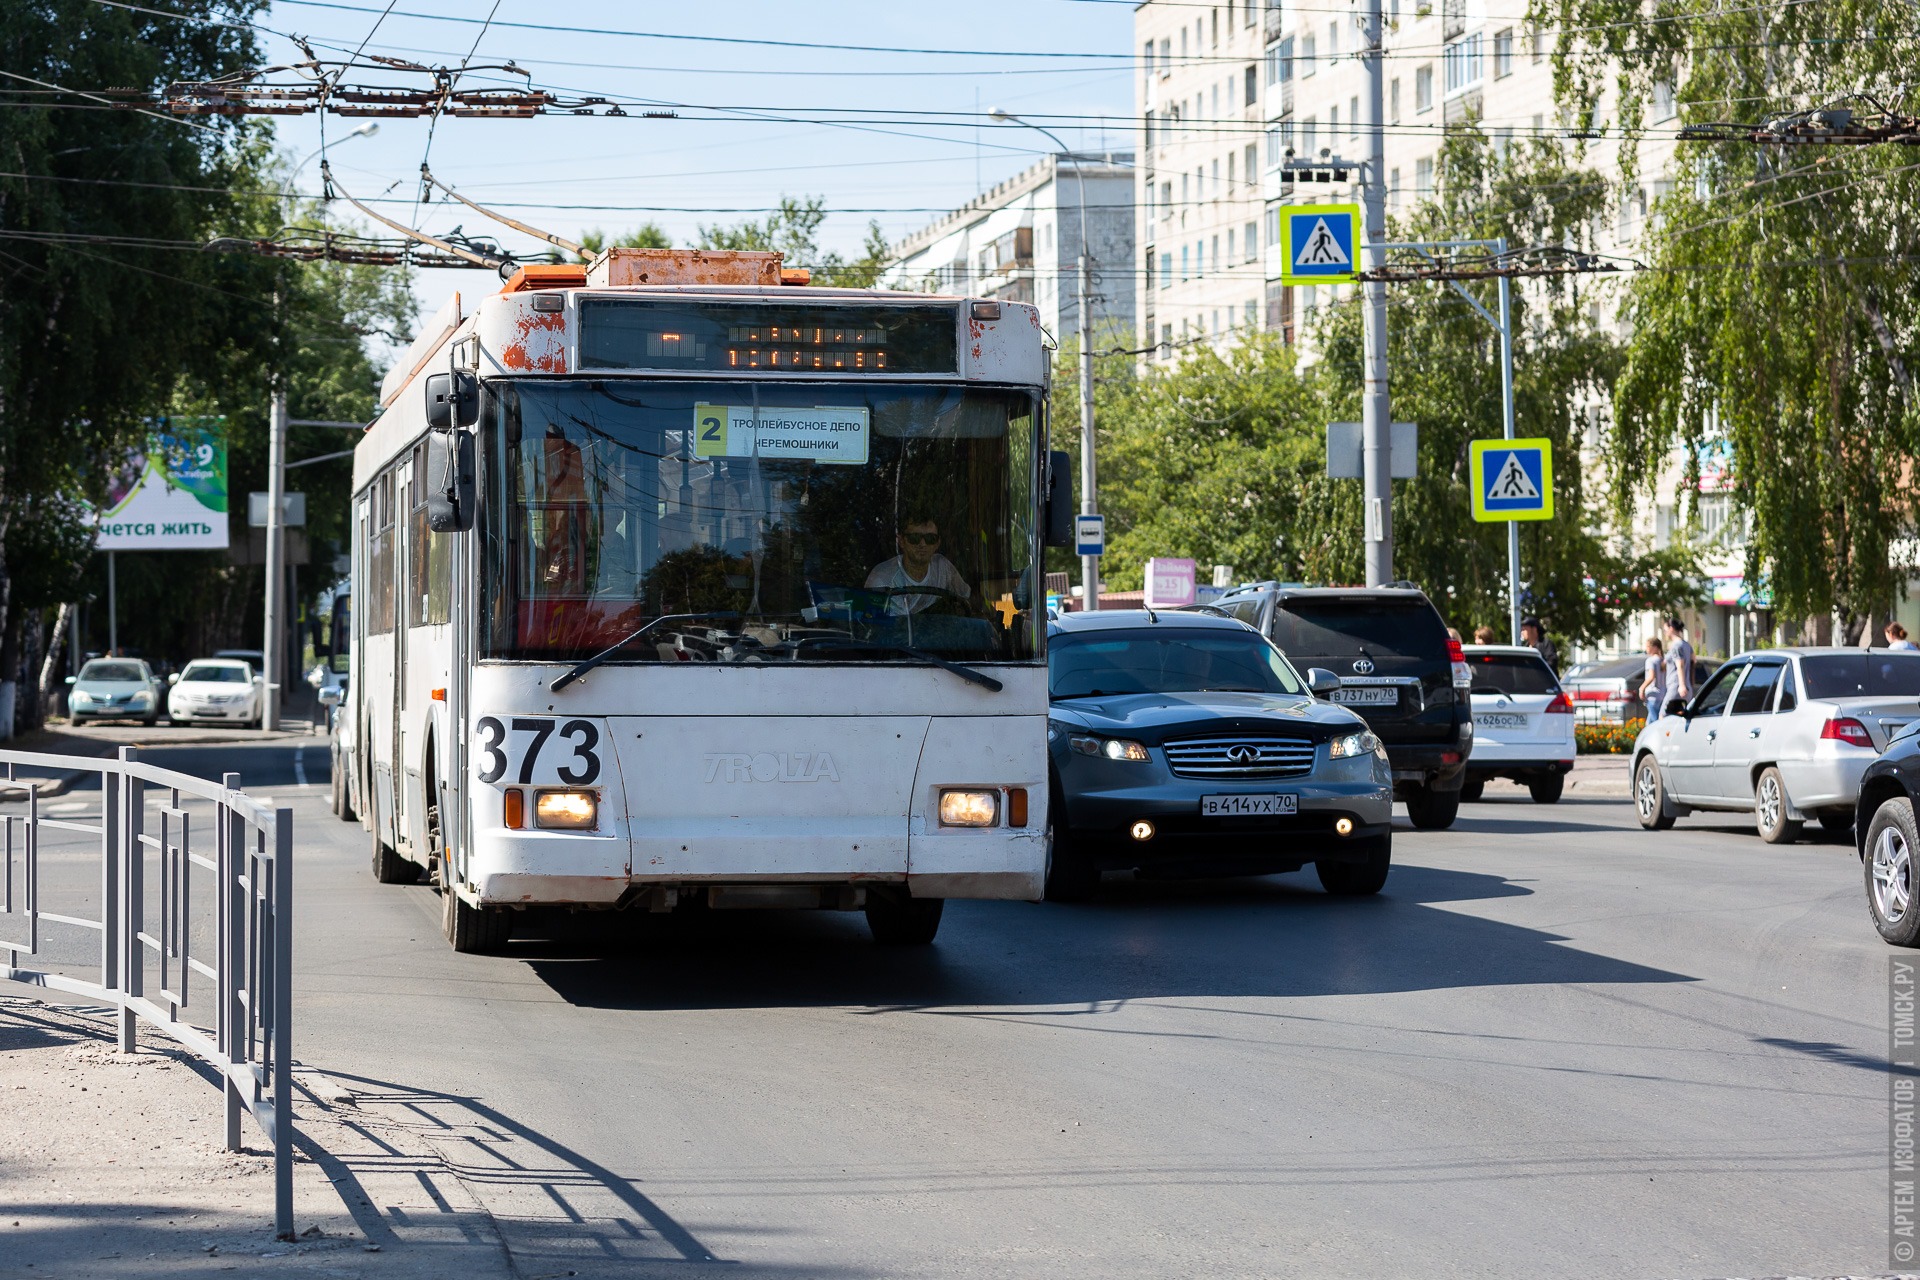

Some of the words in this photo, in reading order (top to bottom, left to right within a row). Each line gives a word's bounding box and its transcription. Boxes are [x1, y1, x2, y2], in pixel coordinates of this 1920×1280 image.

[701, 417, 721, 441] 2
[830, 422, 861, 432] ДЕПО
[161, 522, 212, 536] жить
[1164, 578, 1178, 589] 15
[1382, 688, 1394, 698] 70
[476, 716, 600, 786] 373
[703, 752, 841, 783] TROLZA
[1276, 796, 1291, 807] 70
